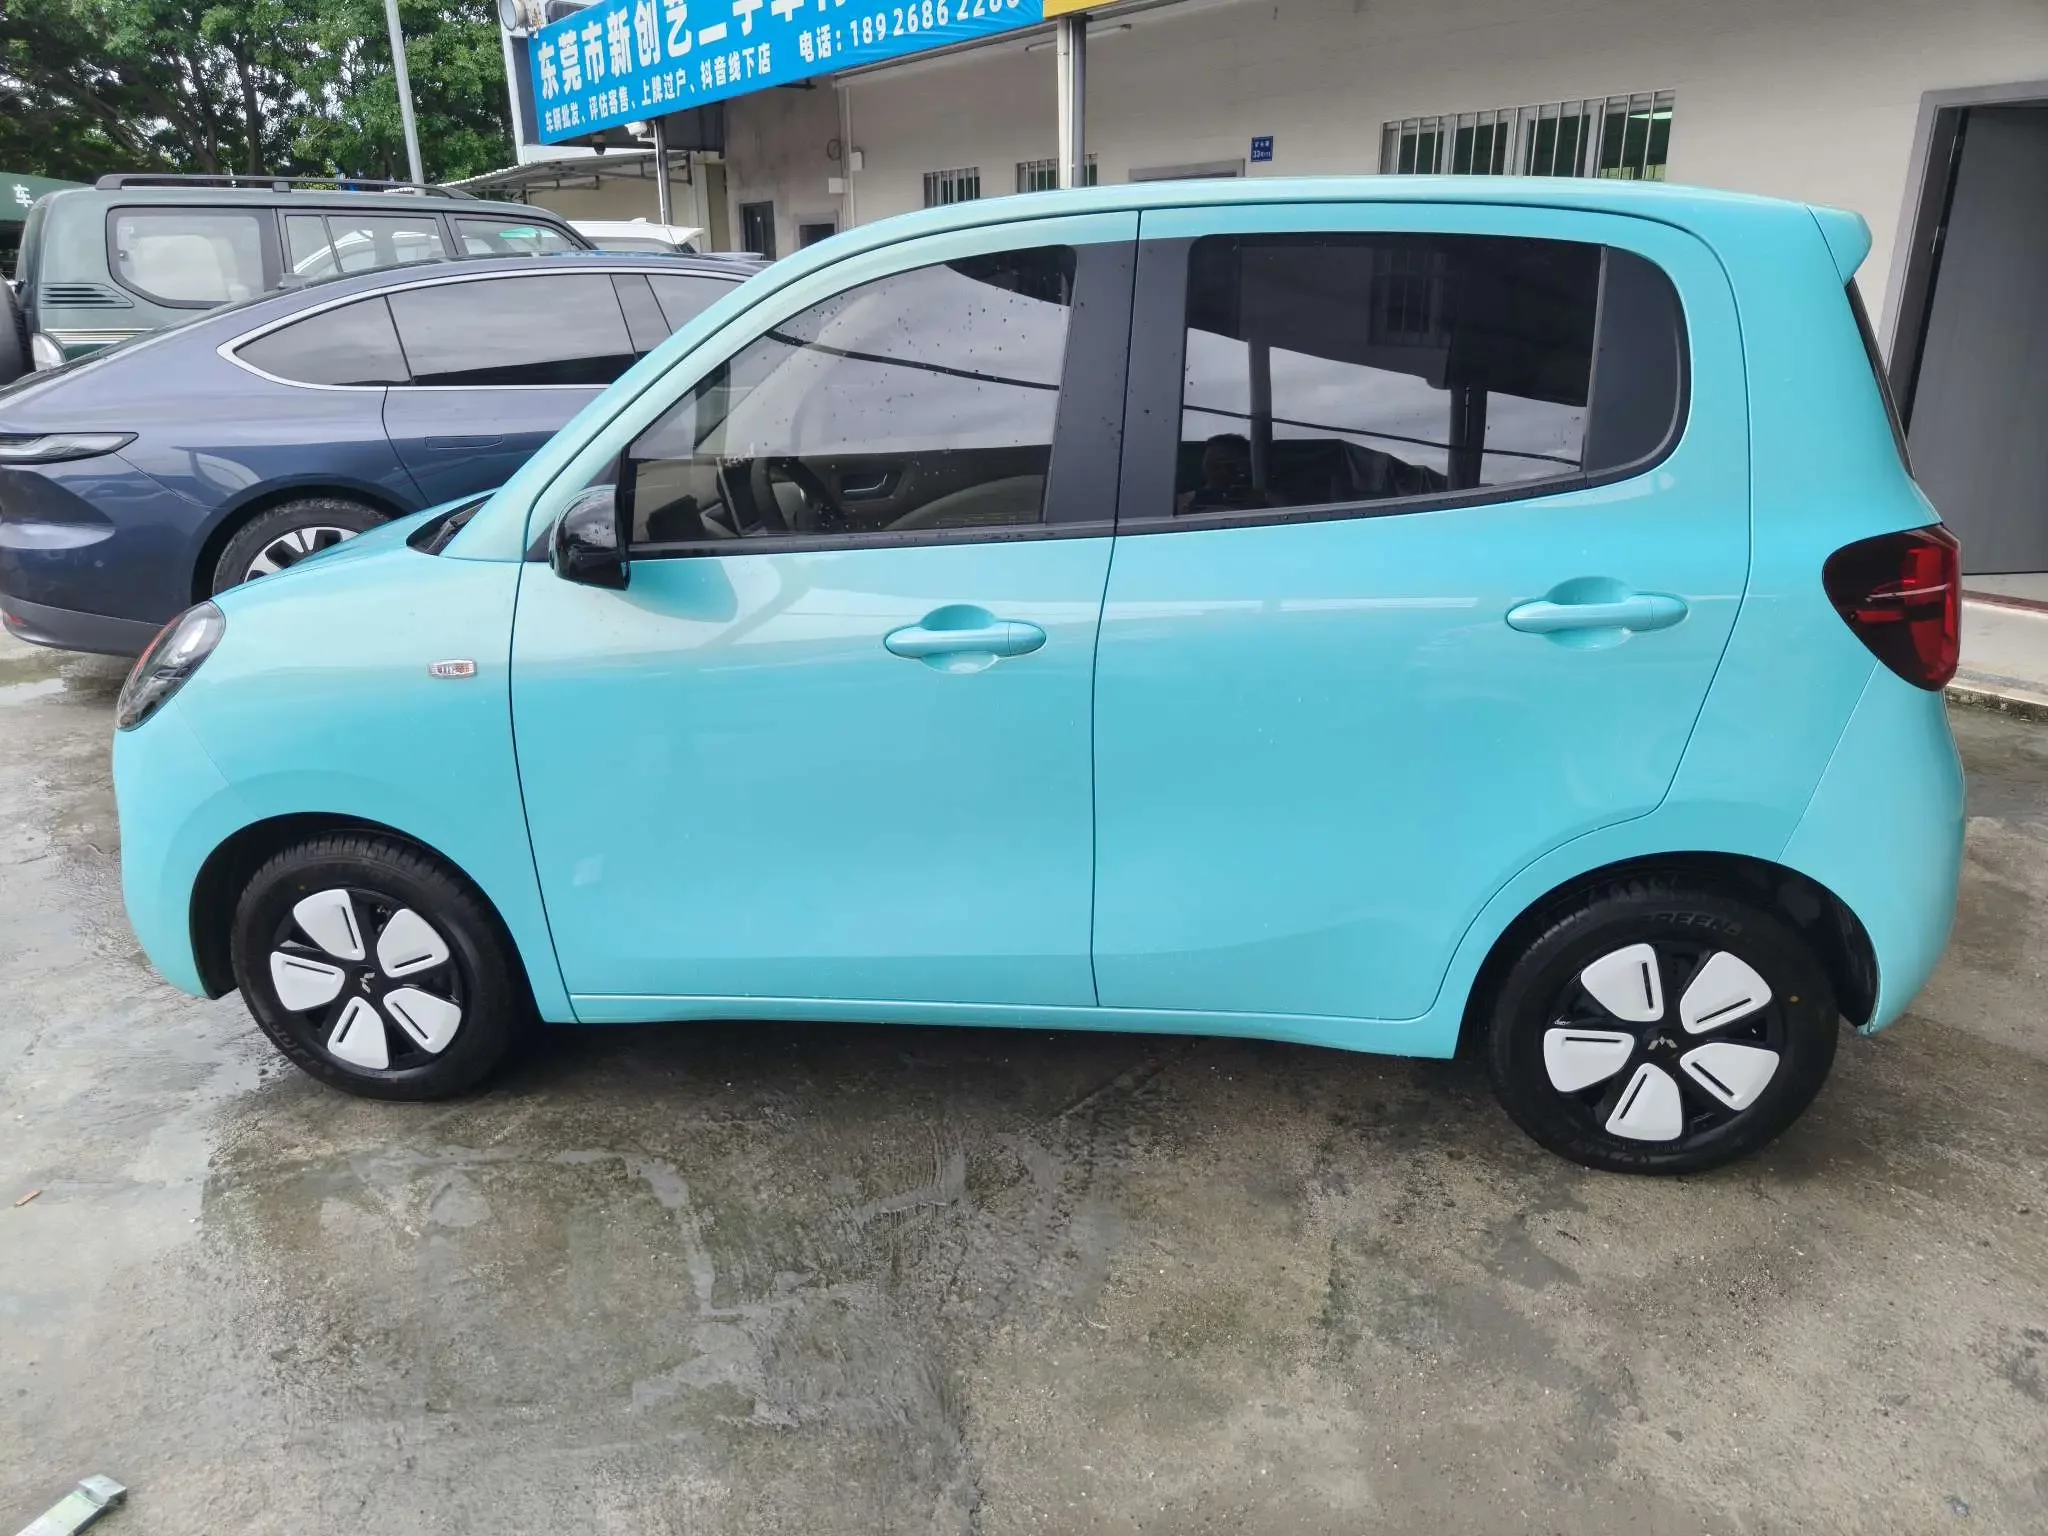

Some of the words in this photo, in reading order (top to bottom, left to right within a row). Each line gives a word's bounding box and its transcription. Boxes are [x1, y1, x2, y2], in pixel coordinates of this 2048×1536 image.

[537, 0, 847, 100] 东莞市新创艺二手
